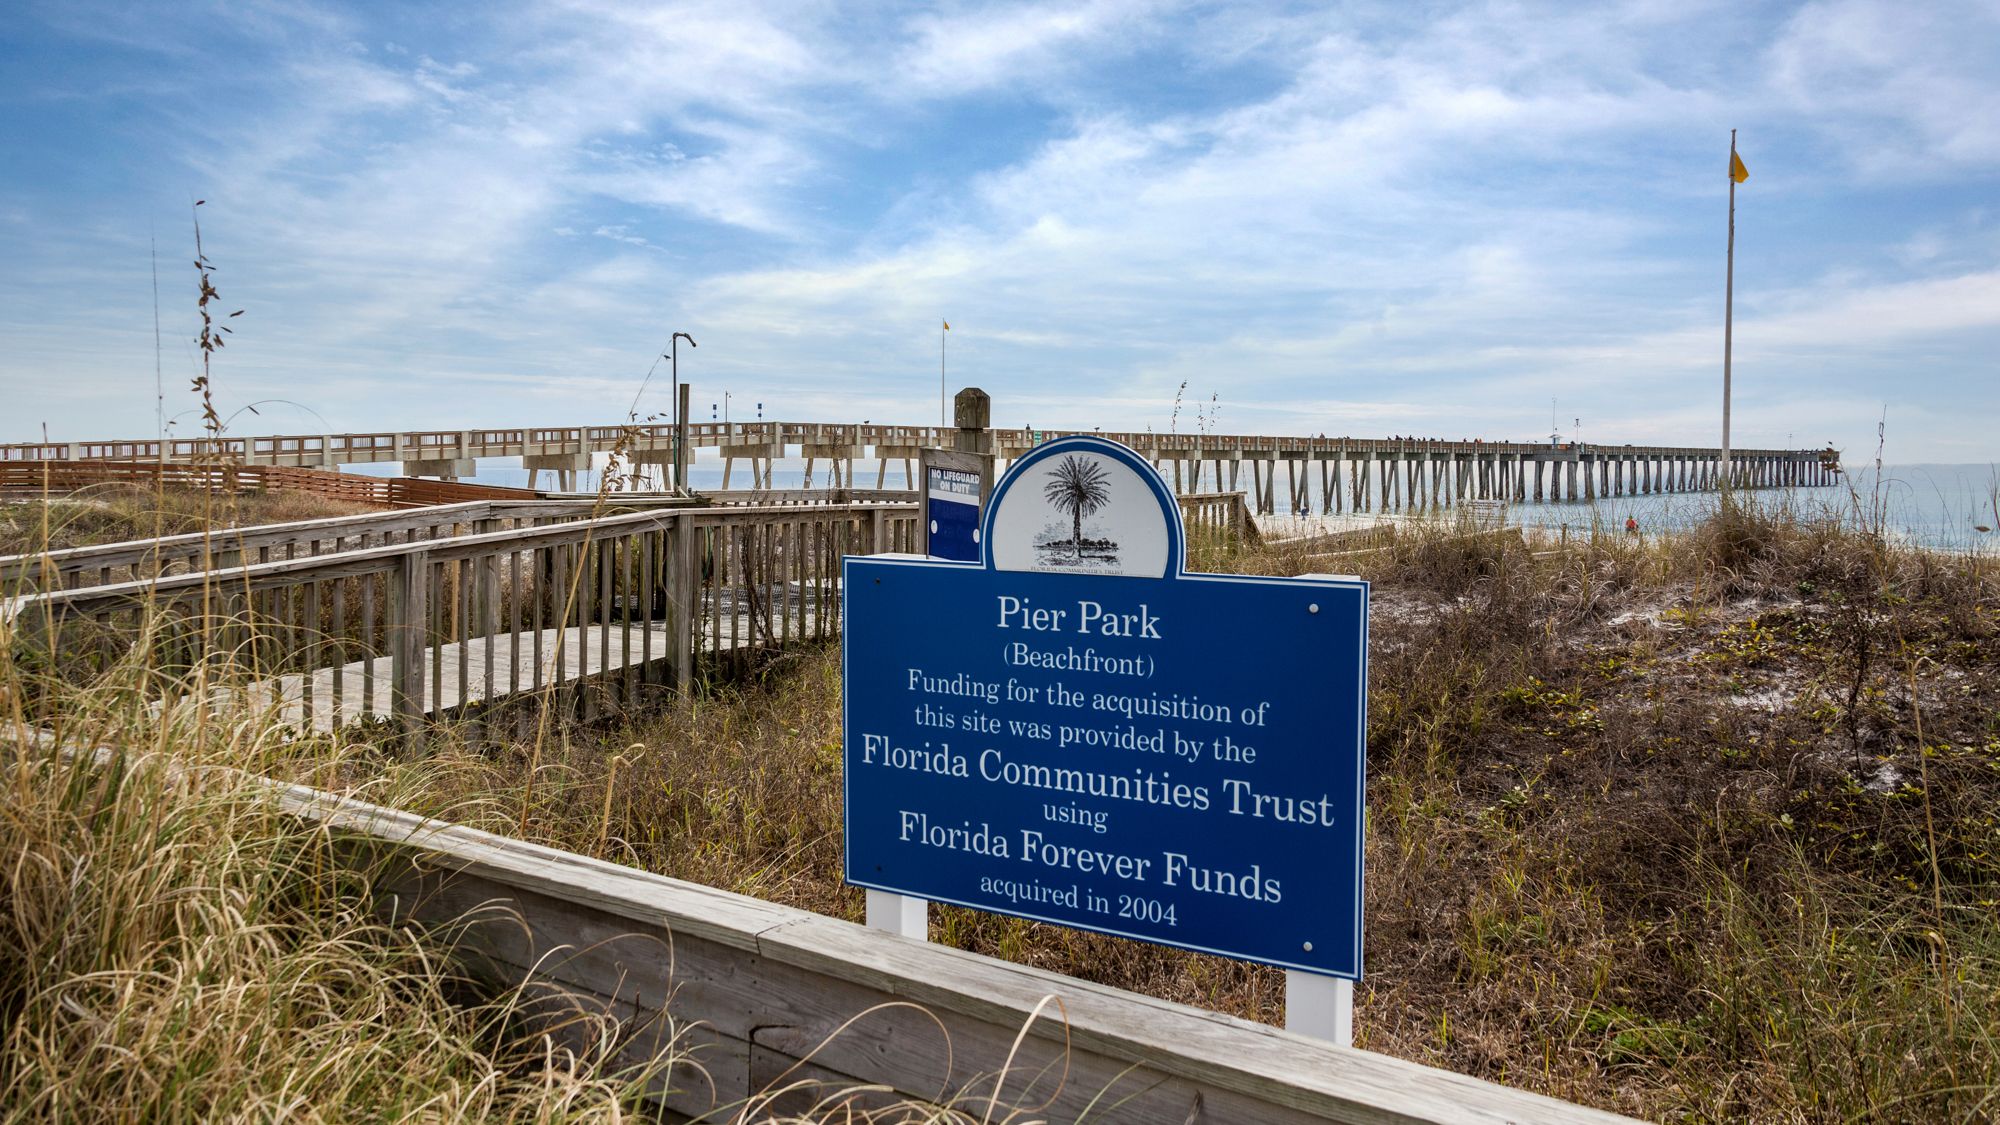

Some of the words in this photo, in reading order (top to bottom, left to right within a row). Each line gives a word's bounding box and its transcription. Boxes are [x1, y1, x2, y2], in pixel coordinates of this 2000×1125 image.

[931, 469, 941, 479] NO
[943, 471, 980, 484] LIFEGUARD
[940, 482, 950, 491] ON
[952, 483, 970, 494] DUTY
[997, 595, 1067, 632] Pier
[1077, 600, 1162, 639] Park
[1004, 642, 1154, 677] (Beachfront)
[908, 668, 999, 704] Funding
[1007, 678, 1039, 703] for
[1046, 682, 1085, 708] the
[1092, 692, 1232, 723] acquisition
[1241, 702, 1270, 726] of
[915, 703, 955, 727] this
[962, 710, 1001, 734] site
[1008, 720, 1052, 740] was
[1059, 725, 1165, 754] provided
[1174, 730, 1204, 763] by
[1212, 736, 1256, 764] the
[862, 733, 969, 778] Florida
[979, 749, 1210, 812] Communities
[1223, 779, 1335, 827] Trust
[1043, 801, 1109, 833] using
[899, 810, 1010, 858] Florida
[1020, 829, 1151, 883] Forever
[1163, 851, 1282, 903] Funds
[980, 878, 1078, 909] acquired
[1088, 895, 1109, 914] in
[1118, 895, 1177, 926] 2004
